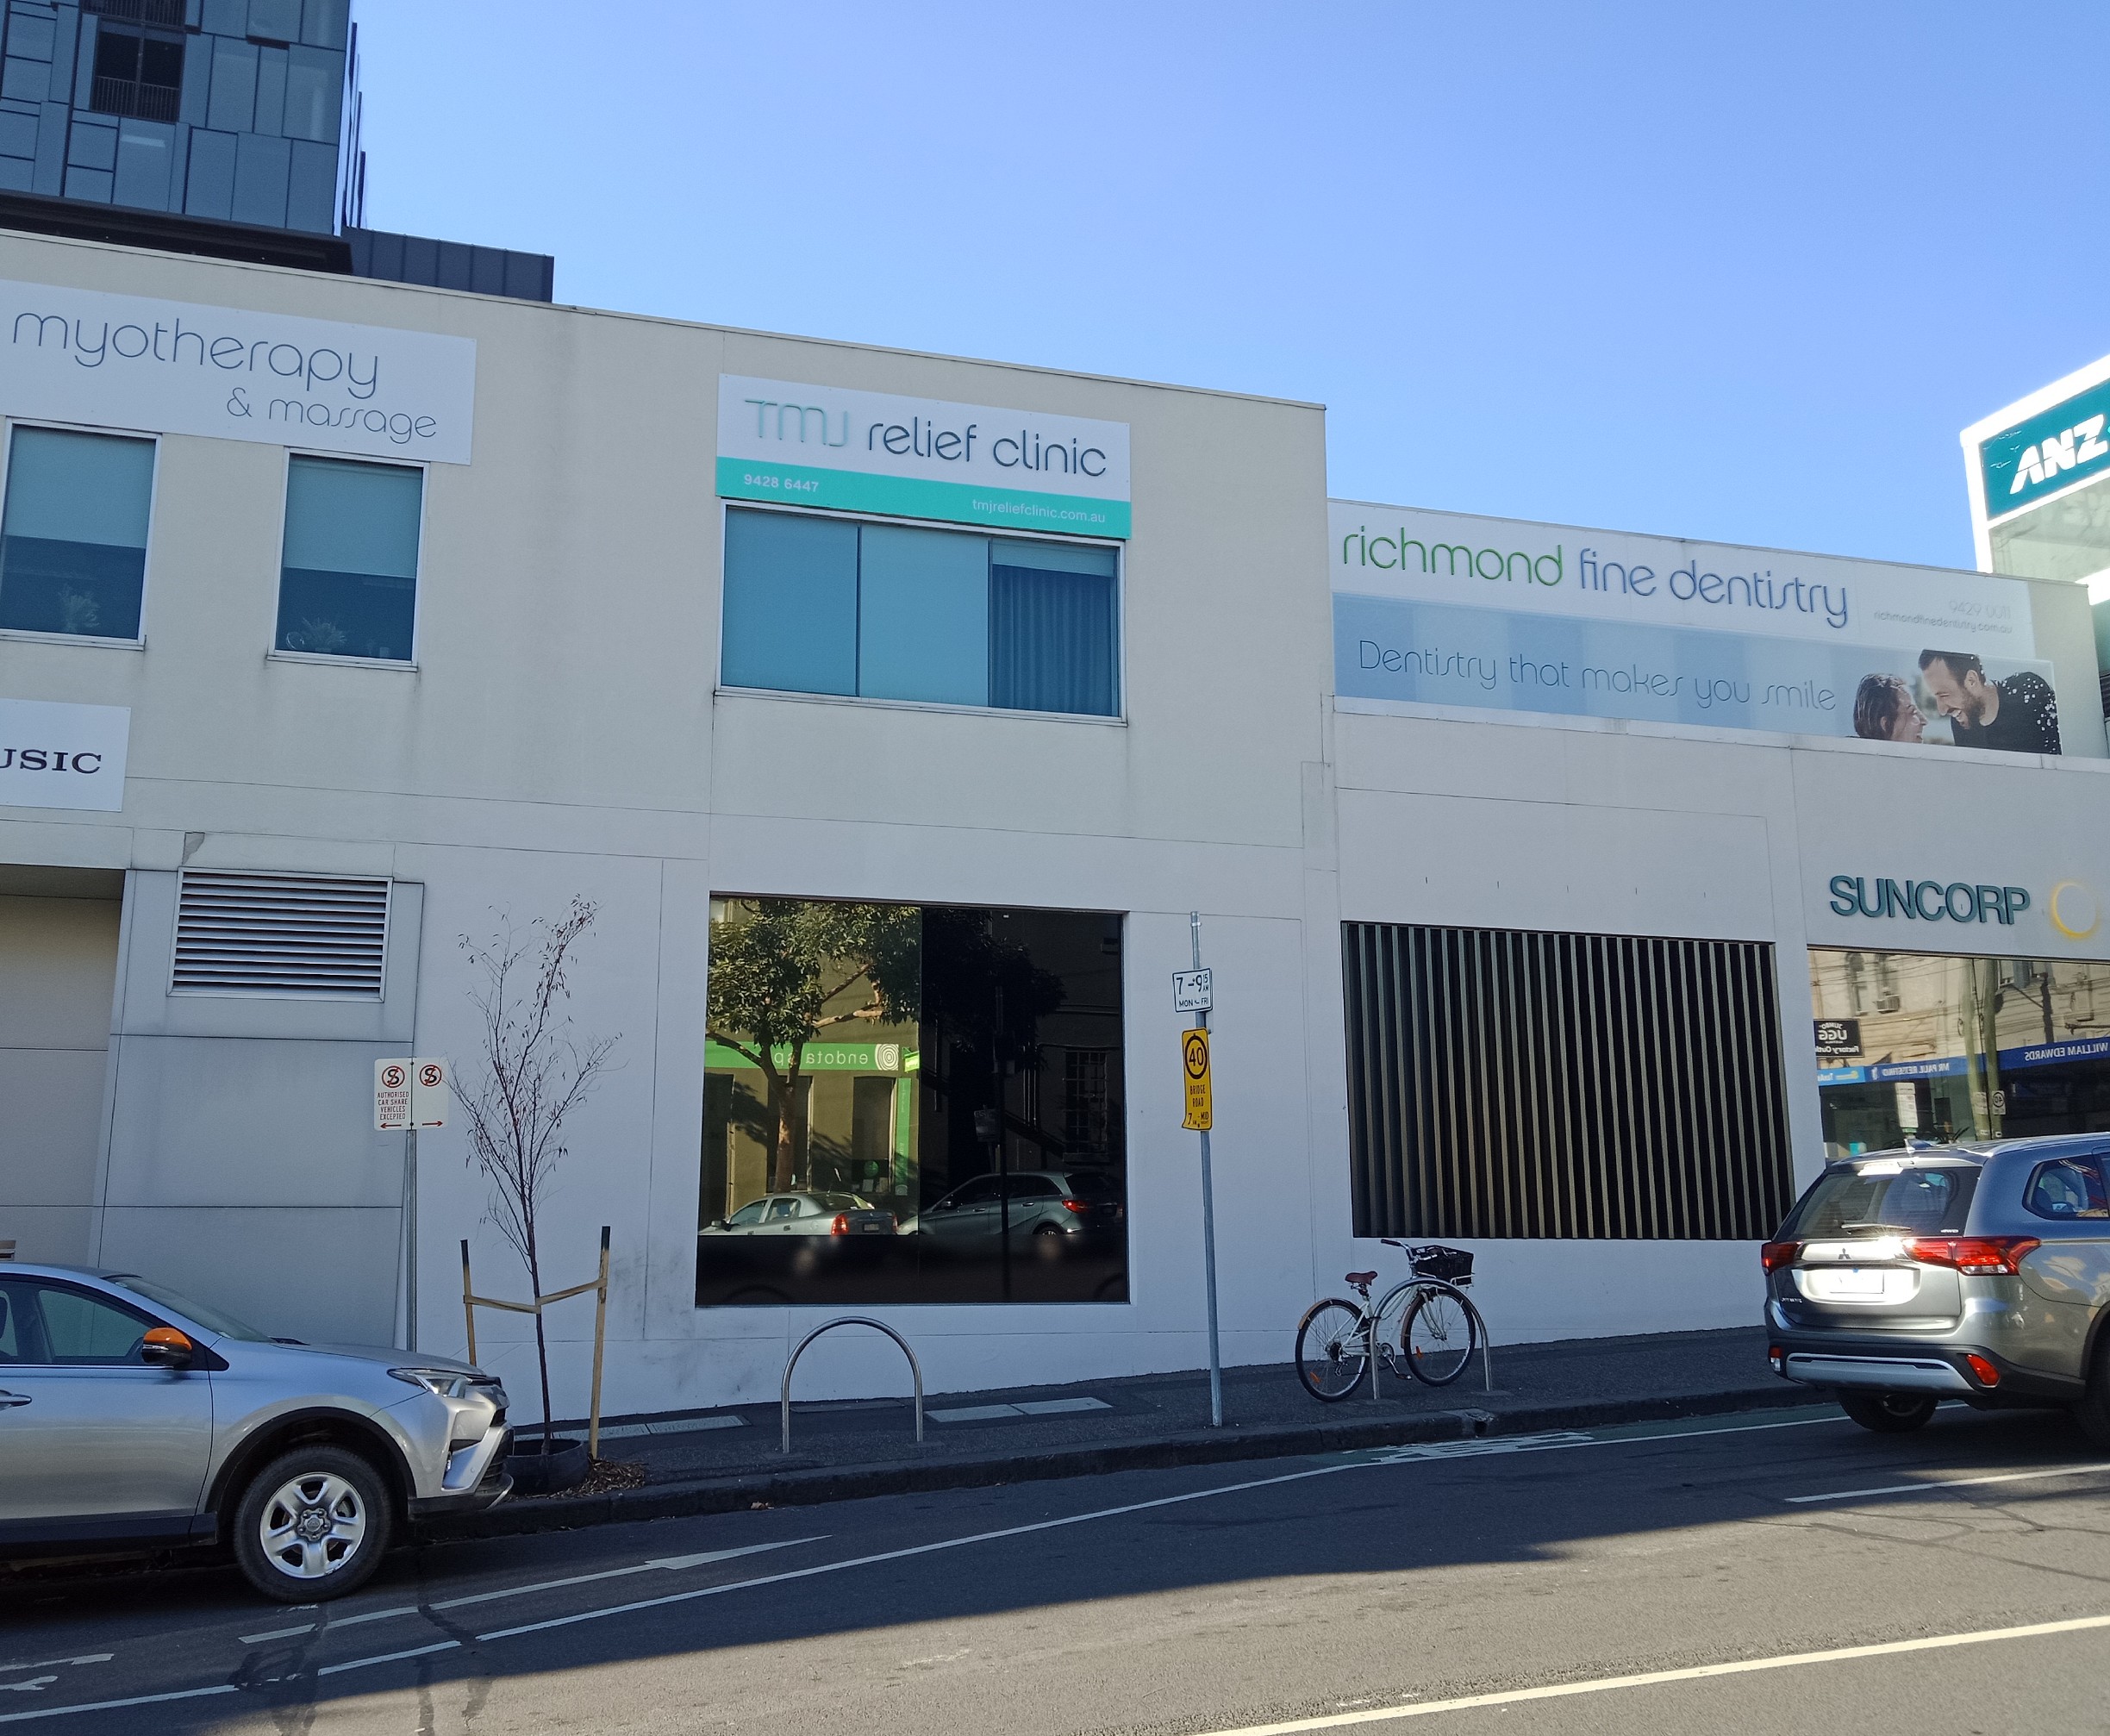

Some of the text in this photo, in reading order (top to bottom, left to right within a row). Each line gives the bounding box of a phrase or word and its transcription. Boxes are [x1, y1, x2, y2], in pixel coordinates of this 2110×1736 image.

[13, 312, 378, 400] myotherapy
[227, 387, 437, 445] & massage
[745, 398, 1107, 477] TMJ relief clinic
[2009, 413, 2108, 495] ANZ
[743, 473, 820, 493] 9428 6447
[971, 498, 1107, 524] tmjreliefclinic.com.au
[1343, 525, 1848, 629] richmond fine dentistry
[1949, 599, 1982, 617] 9429
[1359, 640, 1837, 712] Dentistry that makes you smile
[1829, 874, 2032, 926] SUNCORP
[1176, 977, 1183, 995] 7
[1188, 1046, 1205, 1066] 40
[1189, 1084, 1206, 1096] BRIDGE
[1192, 1097, 1204, 1108] ROAD
[1200, 1112, 1209, 1121] MID
